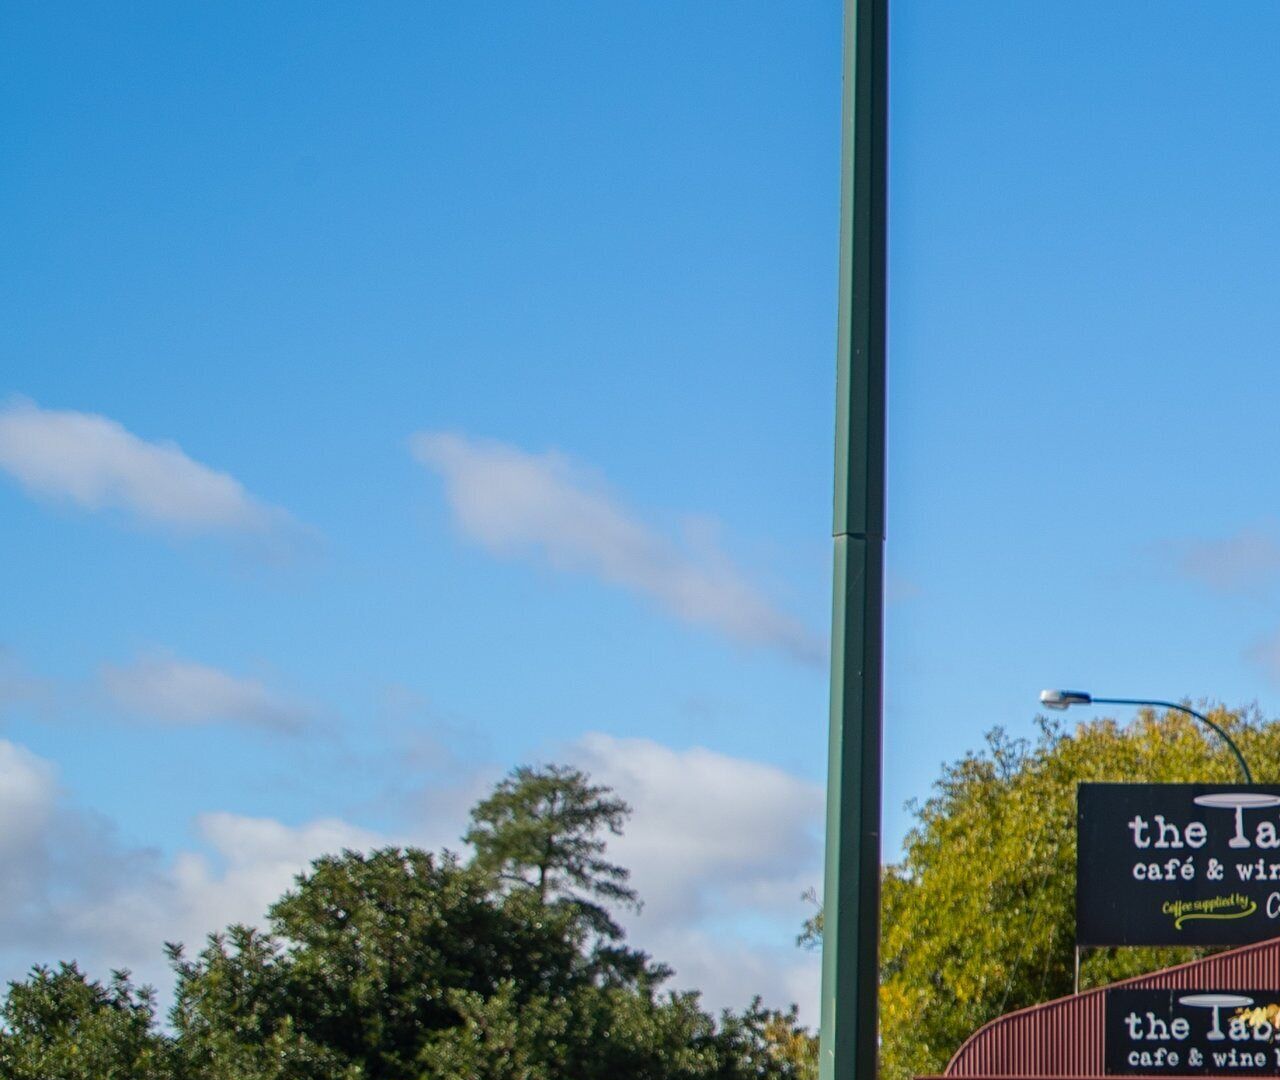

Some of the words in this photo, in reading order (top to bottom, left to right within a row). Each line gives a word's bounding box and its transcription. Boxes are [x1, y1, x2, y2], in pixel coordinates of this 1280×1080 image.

[1128, 815, 1208, 849] the
[1132, 856, 1195, 881] café
[1206, 858, 1224, 880] &
[1125, 1012, 1190, 1041] the
[1188, 1048, 1203, 1067] &
[1212, 1048, 1267, 1067] wine
